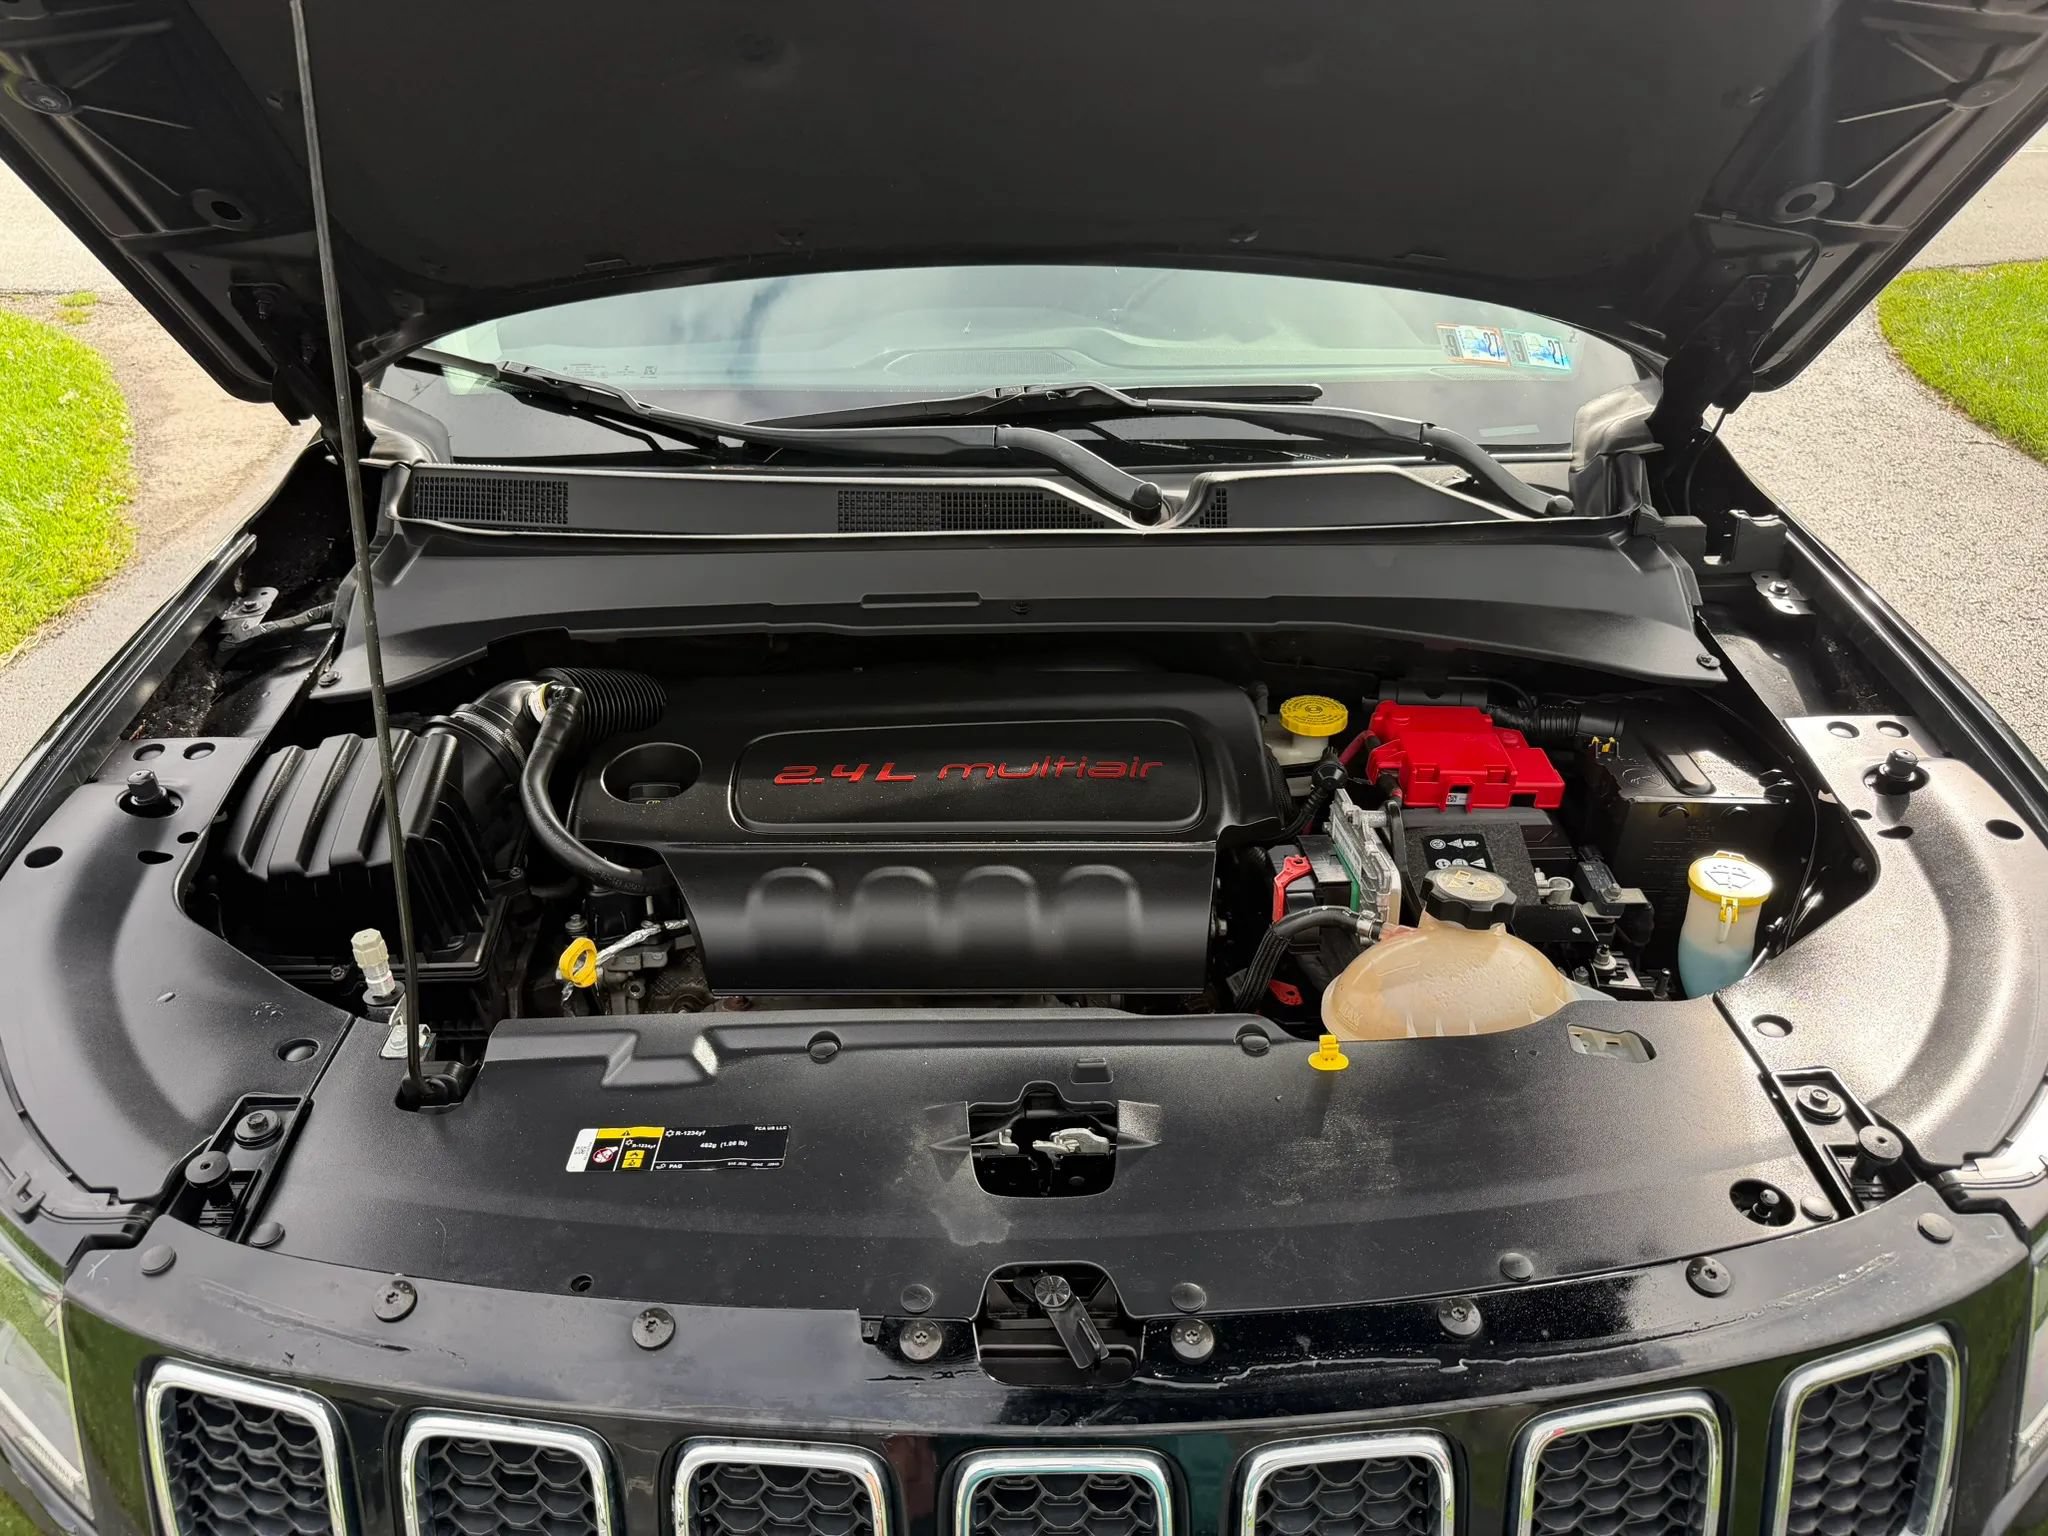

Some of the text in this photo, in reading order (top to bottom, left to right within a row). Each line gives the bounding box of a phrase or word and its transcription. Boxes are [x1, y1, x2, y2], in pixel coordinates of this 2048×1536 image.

[1483, 332, 1501, 360] 27
[1547, 340, 1565, 366] 27
[936, 755, 1164, 779] multiair
